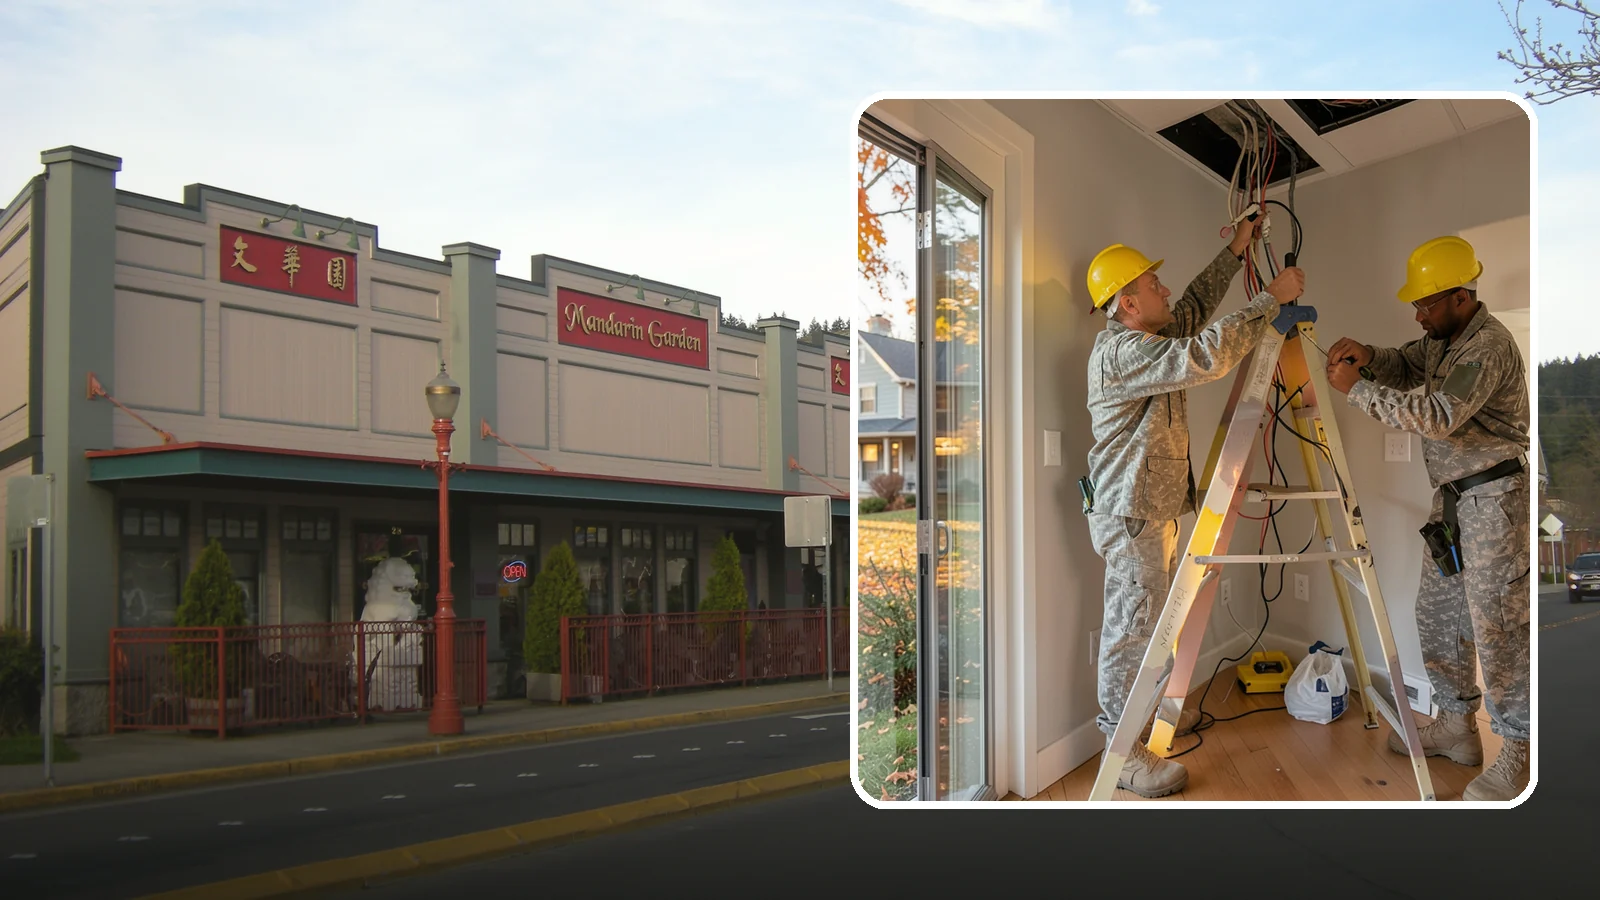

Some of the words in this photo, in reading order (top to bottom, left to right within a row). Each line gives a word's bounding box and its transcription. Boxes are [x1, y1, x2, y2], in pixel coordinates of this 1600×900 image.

[230, 235, 347, 291] 文華園
[564, 302, 644, 342] Mandarin
[647, 320, 701, 352] Garden
[503, 565, 527, 578] OPEN
